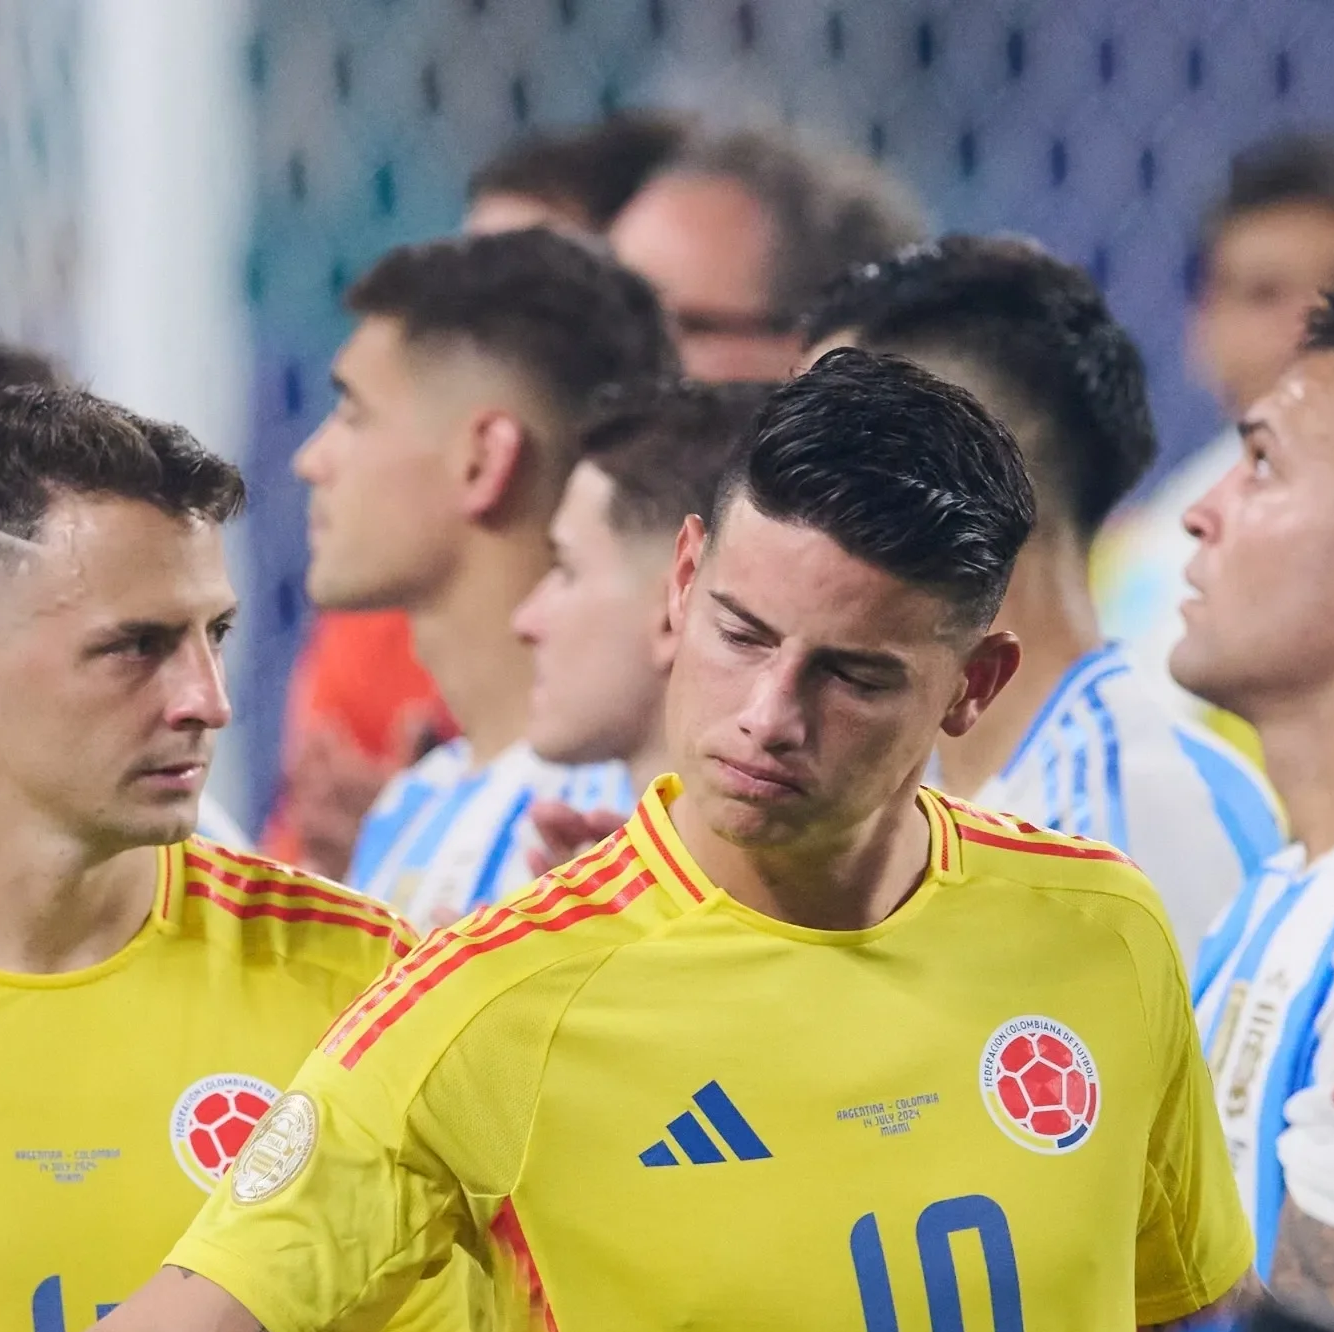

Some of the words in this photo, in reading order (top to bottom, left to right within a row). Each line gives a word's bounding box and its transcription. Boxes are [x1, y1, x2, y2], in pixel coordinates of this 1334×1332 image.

[983, 1032, 1008, 1088] FEDERACION
[1005, 1019, 1062, 1037] COLOMBIANA
[1062, 1032, 1075, 1045] DE
[1072, 1042, 1094, 1080] FUTBOL
[836, 1103, 885, 1120] ARGENTINA
[895, 1092, 940, 1110] COLOMBIA
[863, 1118, 872, 1128] 14
[875, 1113, 895, 1126] JULY
[898, 1109, 921, 1121] 2024
[880, 1122, 911, 1136] MIAMI
